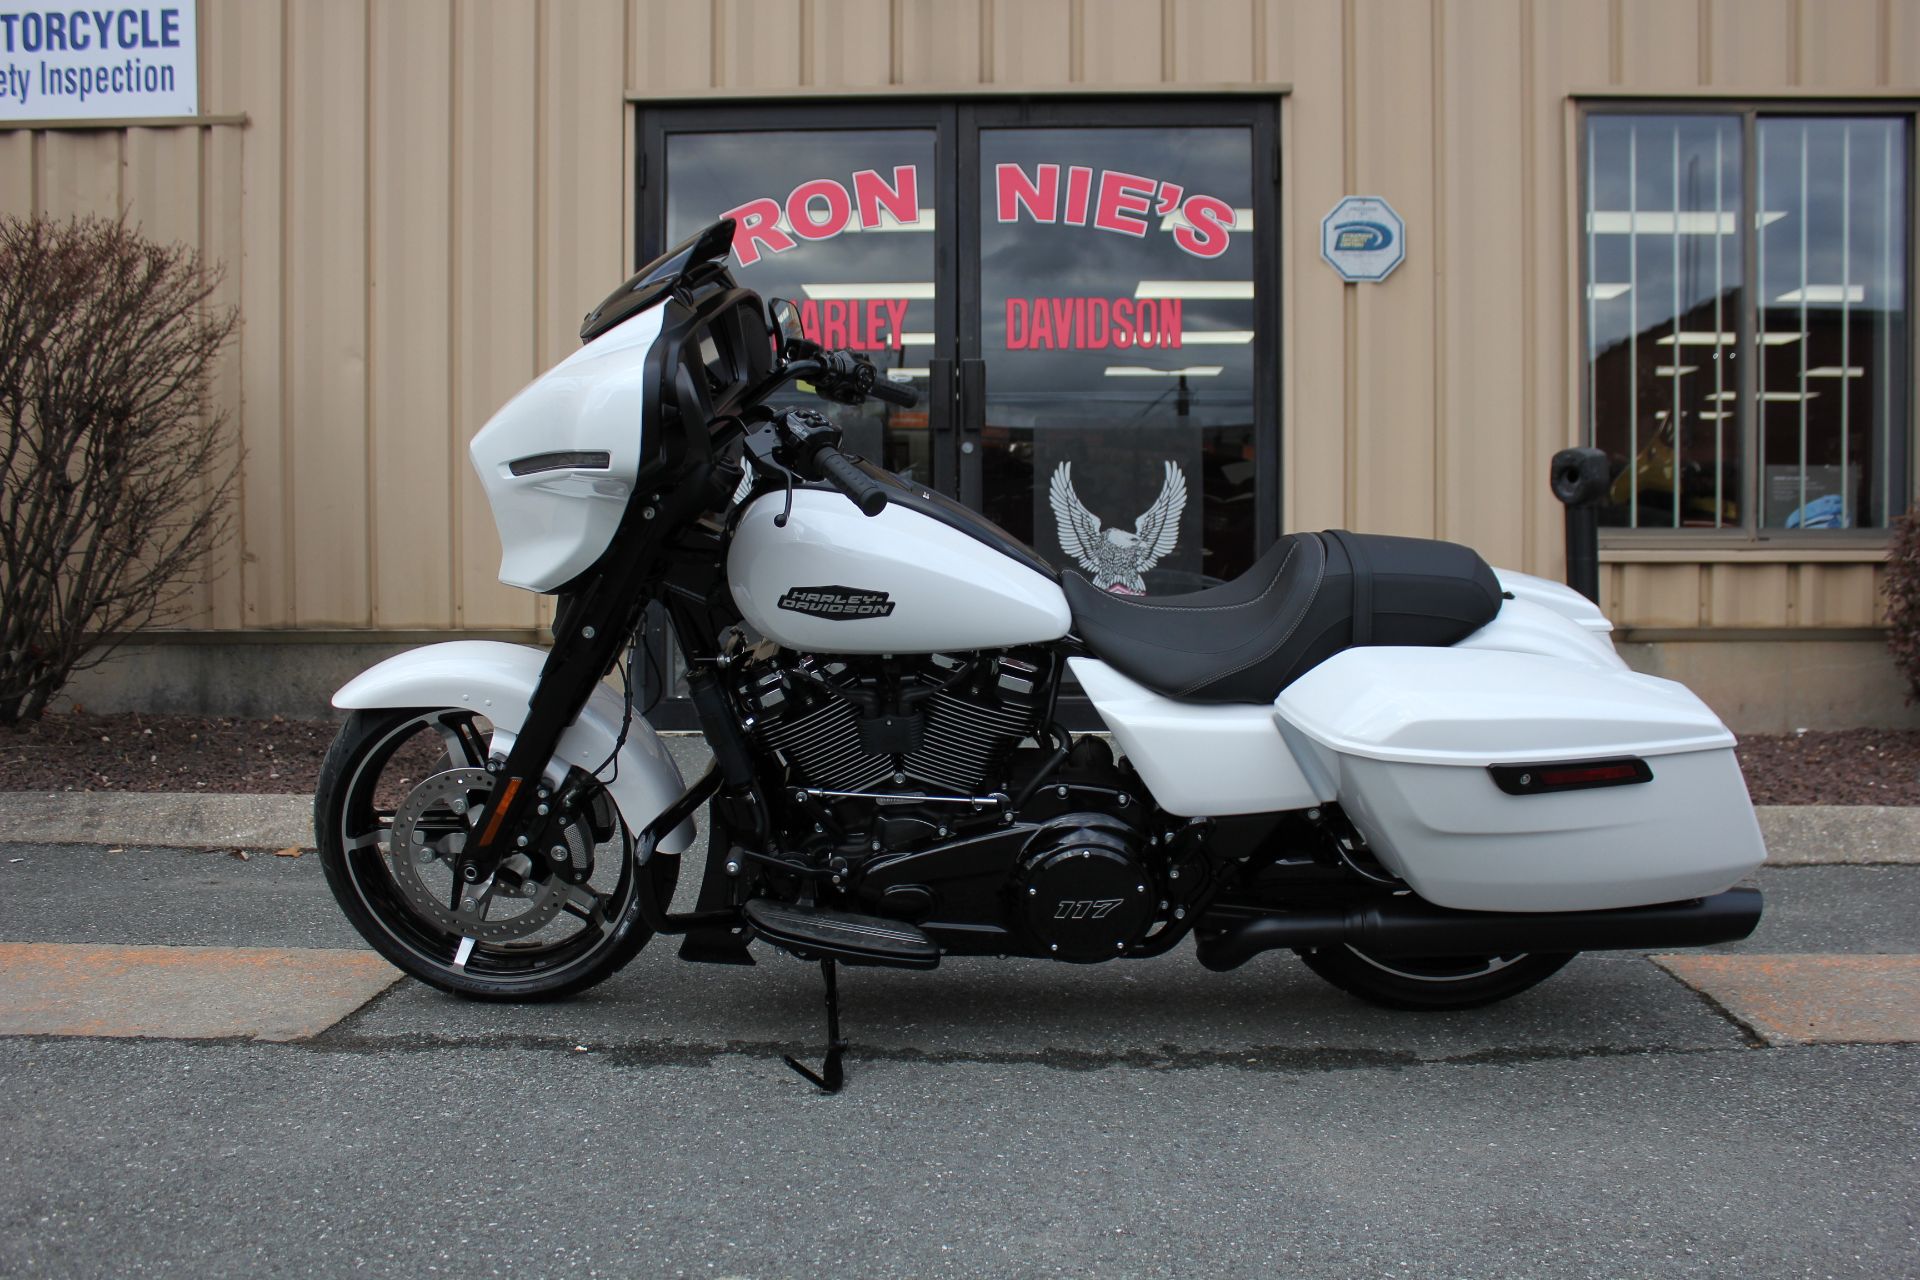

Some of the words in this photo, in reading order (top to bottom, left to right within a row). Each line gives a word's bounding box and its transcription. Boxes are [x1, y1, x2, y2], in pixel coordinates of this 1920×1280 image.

[0, 9, 180, 52] TORCYCLE
[41, 58, 175, 102] Inspection
[719, 165, 919, 267] RON
[996, 163, 1237, 259] NIE'S
[772, 299, 909, 351] ARLEY
[1005, 298, 1183, 350] DAVIDSON
[781, 599, 890, 614] DAVIDSON
[1054, 898, 1125, 919] 117
